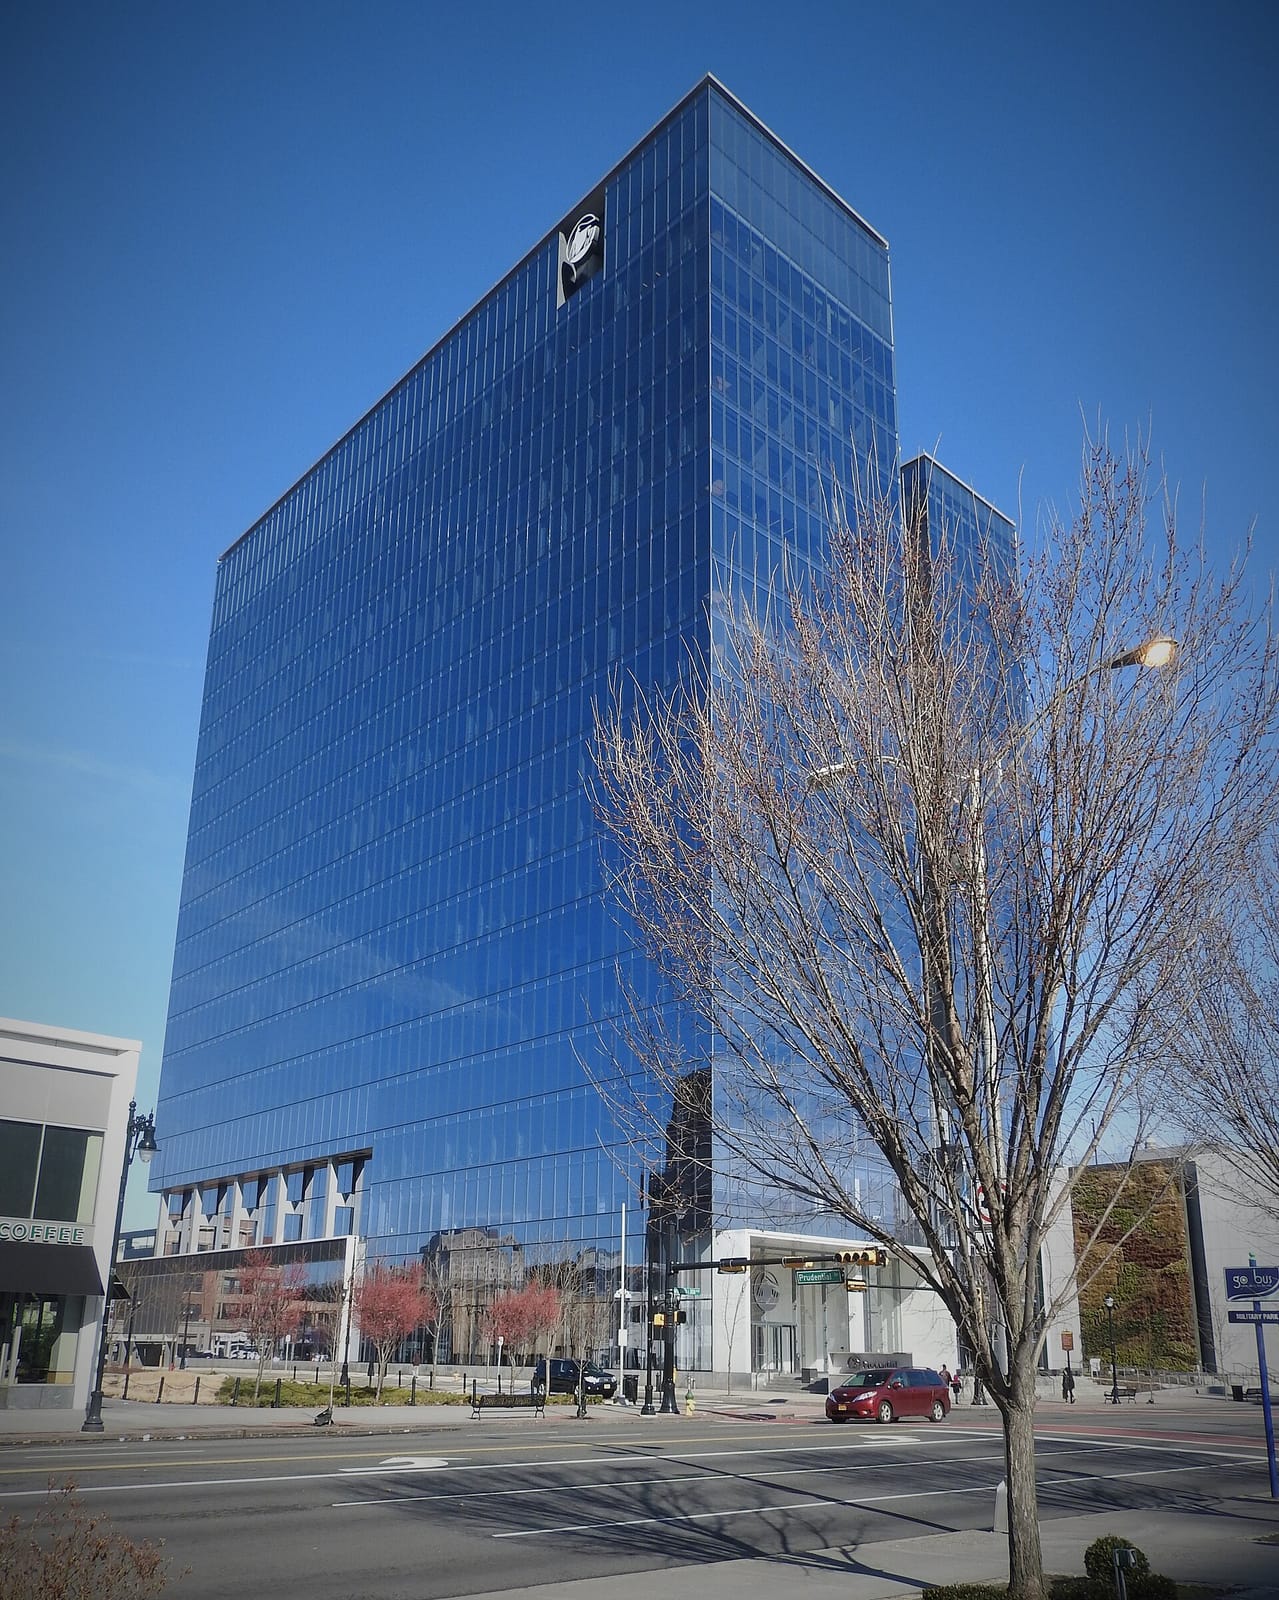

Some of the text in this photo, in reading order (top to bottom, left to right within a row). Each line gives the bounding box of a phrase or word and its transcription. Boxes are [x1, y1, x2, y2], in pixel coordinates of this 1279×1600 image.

[0, 1222, 84, 1245] COFFEE
[798, 1272, 832, 1281] Prudential
[1232, 1268, 1273, 1289] go bus
